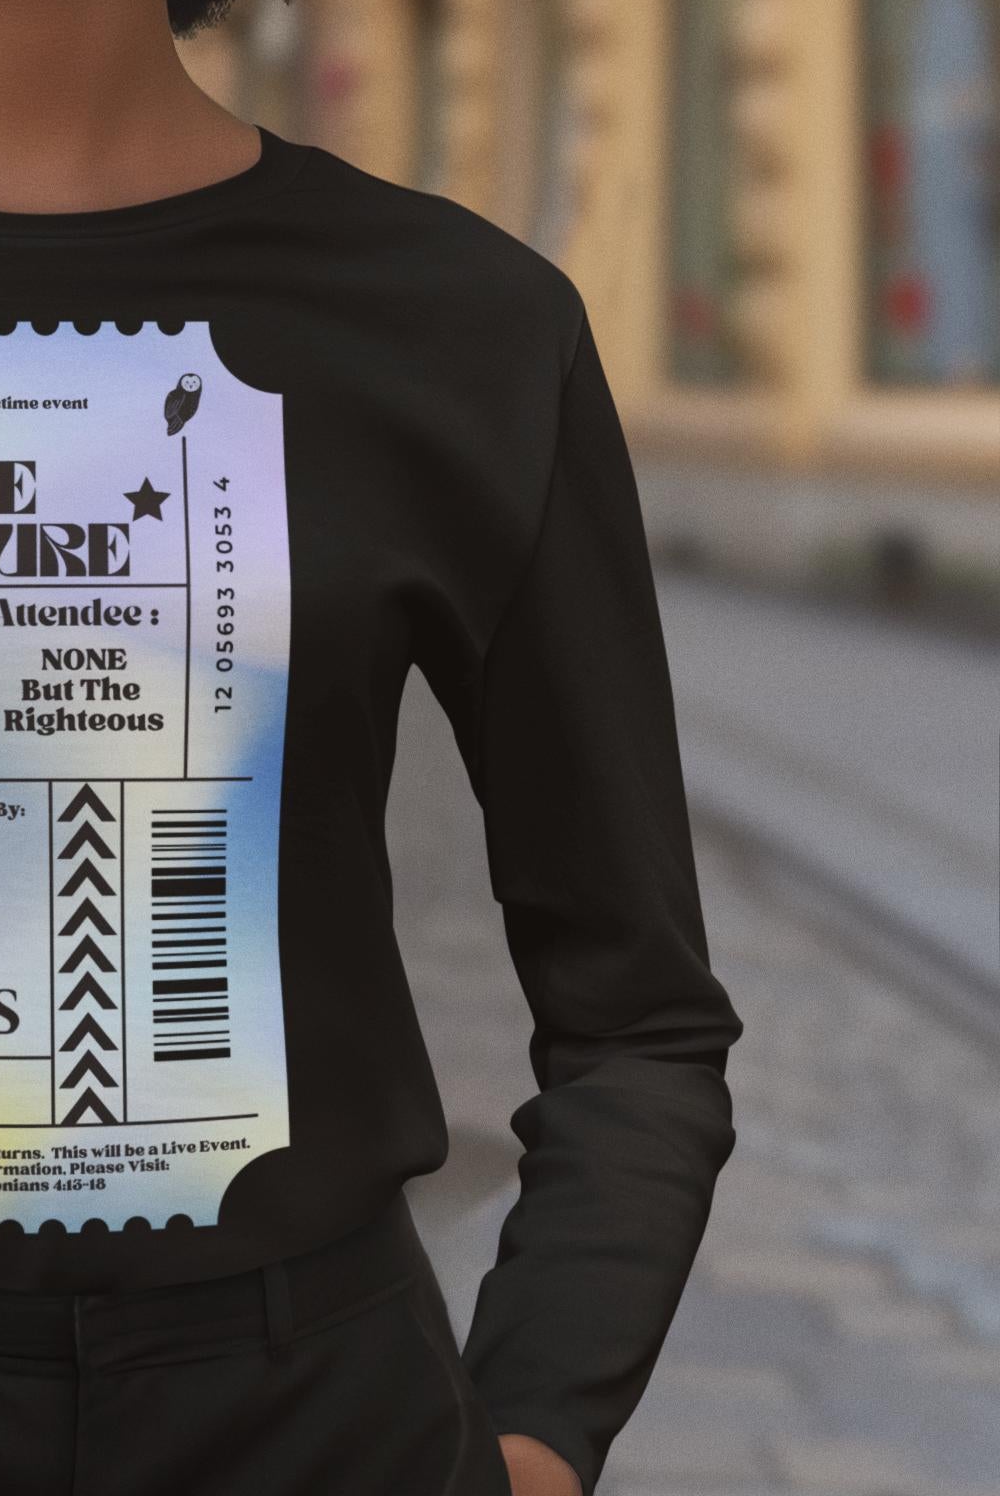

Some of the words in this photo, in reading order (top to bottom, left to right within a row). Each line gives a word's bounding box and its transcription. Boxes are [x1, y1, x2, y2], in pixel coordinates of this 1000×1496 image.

[42, 398, 89, 410] event
[212, 476, 230, 492] 4
[214, 506, 234, 573] 3053
[215, 587, 235, 673] 05693
[41, 648, 128, 671] NONE
[21, 678, 74, 702] But
[79, 676, 141, 701] The
[214, 686, 233, 714] 12
[3, 706, 164, 737] Righteous
[50, 1145, 88, 1160] This
[90, 1143, 121, 1158] will
[124, 1143, 145, 1157] be
[147, 1145, 159, 1156] a
[161, 1140, 197, 1155] Live
[199, 1137, 251, 1153] Event.
[69, 1161, 125, 1175] Please
[128, 1158, 170, 1173] Visit:
